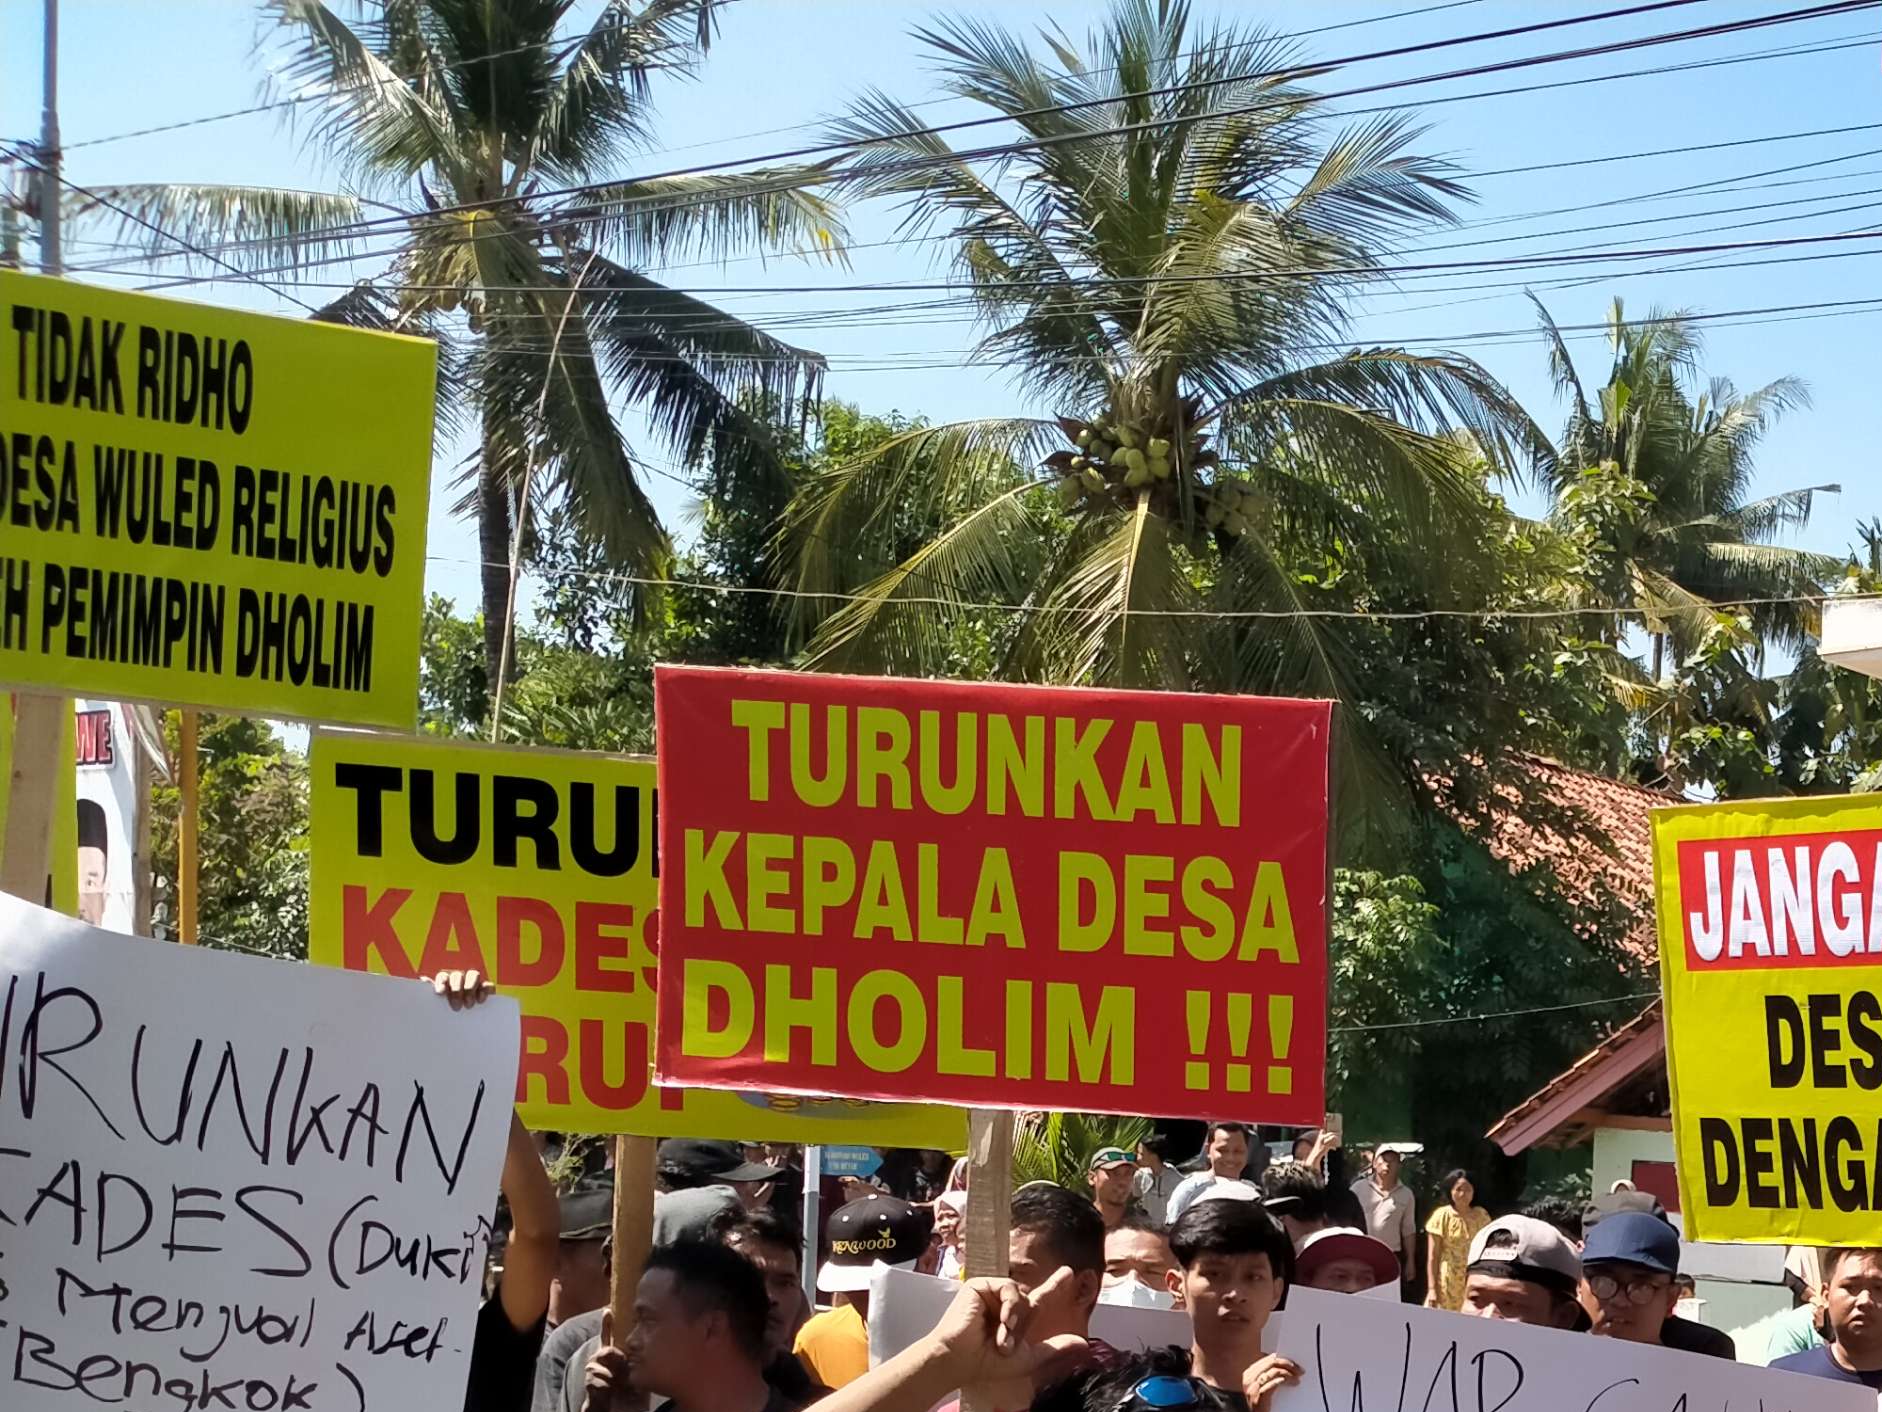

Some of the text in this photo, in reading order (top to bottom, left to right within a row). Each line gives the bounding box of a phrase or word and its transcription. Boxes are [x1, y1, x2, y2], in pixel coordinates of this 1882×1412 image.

[12, 305, 254, 435] TIDAK RIDHO
[94, 444, 221, 551] WULED
[231, 465, 395, 577] RELIGIUS
[42, 562, 225, 675] PEMIMPIN
[236, 588, 375, 692] DHOLIM
[335, 763, 659, 877] TURU
[731, 699, 1242, 828] TURUNKAN
[343, 884, 660, 993] KADE
[684, 828, 1299, 964] KEPALA DESA
[0, 971, 485, 1195] RUNKAN
[682, 958, 1293, 1094] DHOLIM !!!
